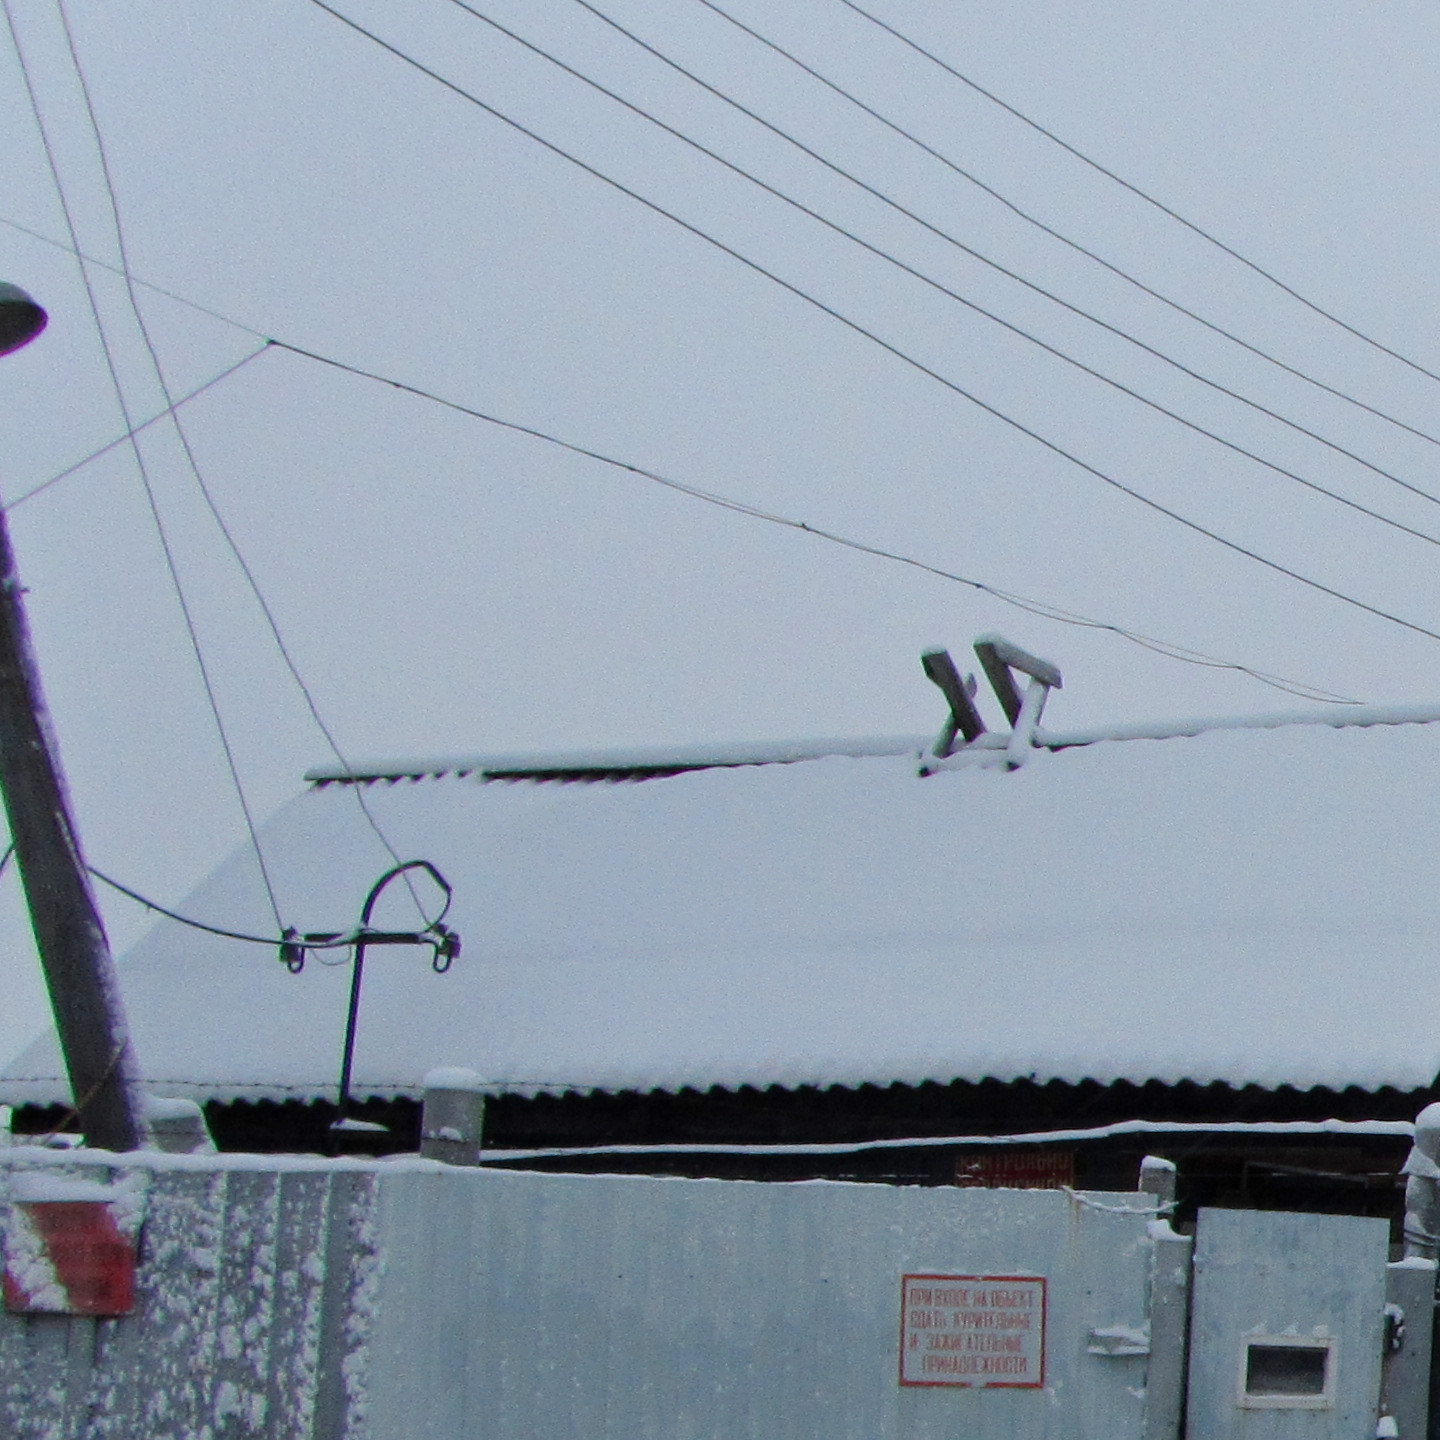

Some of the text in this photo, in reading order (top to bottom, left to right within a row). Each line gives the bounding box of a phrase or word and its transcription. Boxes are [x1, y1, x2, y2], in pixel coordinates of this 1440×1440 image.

[911, 1289, 1033, 1308] ПРИ ВХОДЕ НА ОБЪЕКТ
[911, 1311, 1031, 1329] СДАТЬ КУРИТЕЛЬНЫЕ
[909, 1333, 1023, 1351] И ЗАЖИГАТЕЛЬНЫЕ
[923, 1355, 1028, 1373] ПРИНАДЛЕЖНОСТИ
